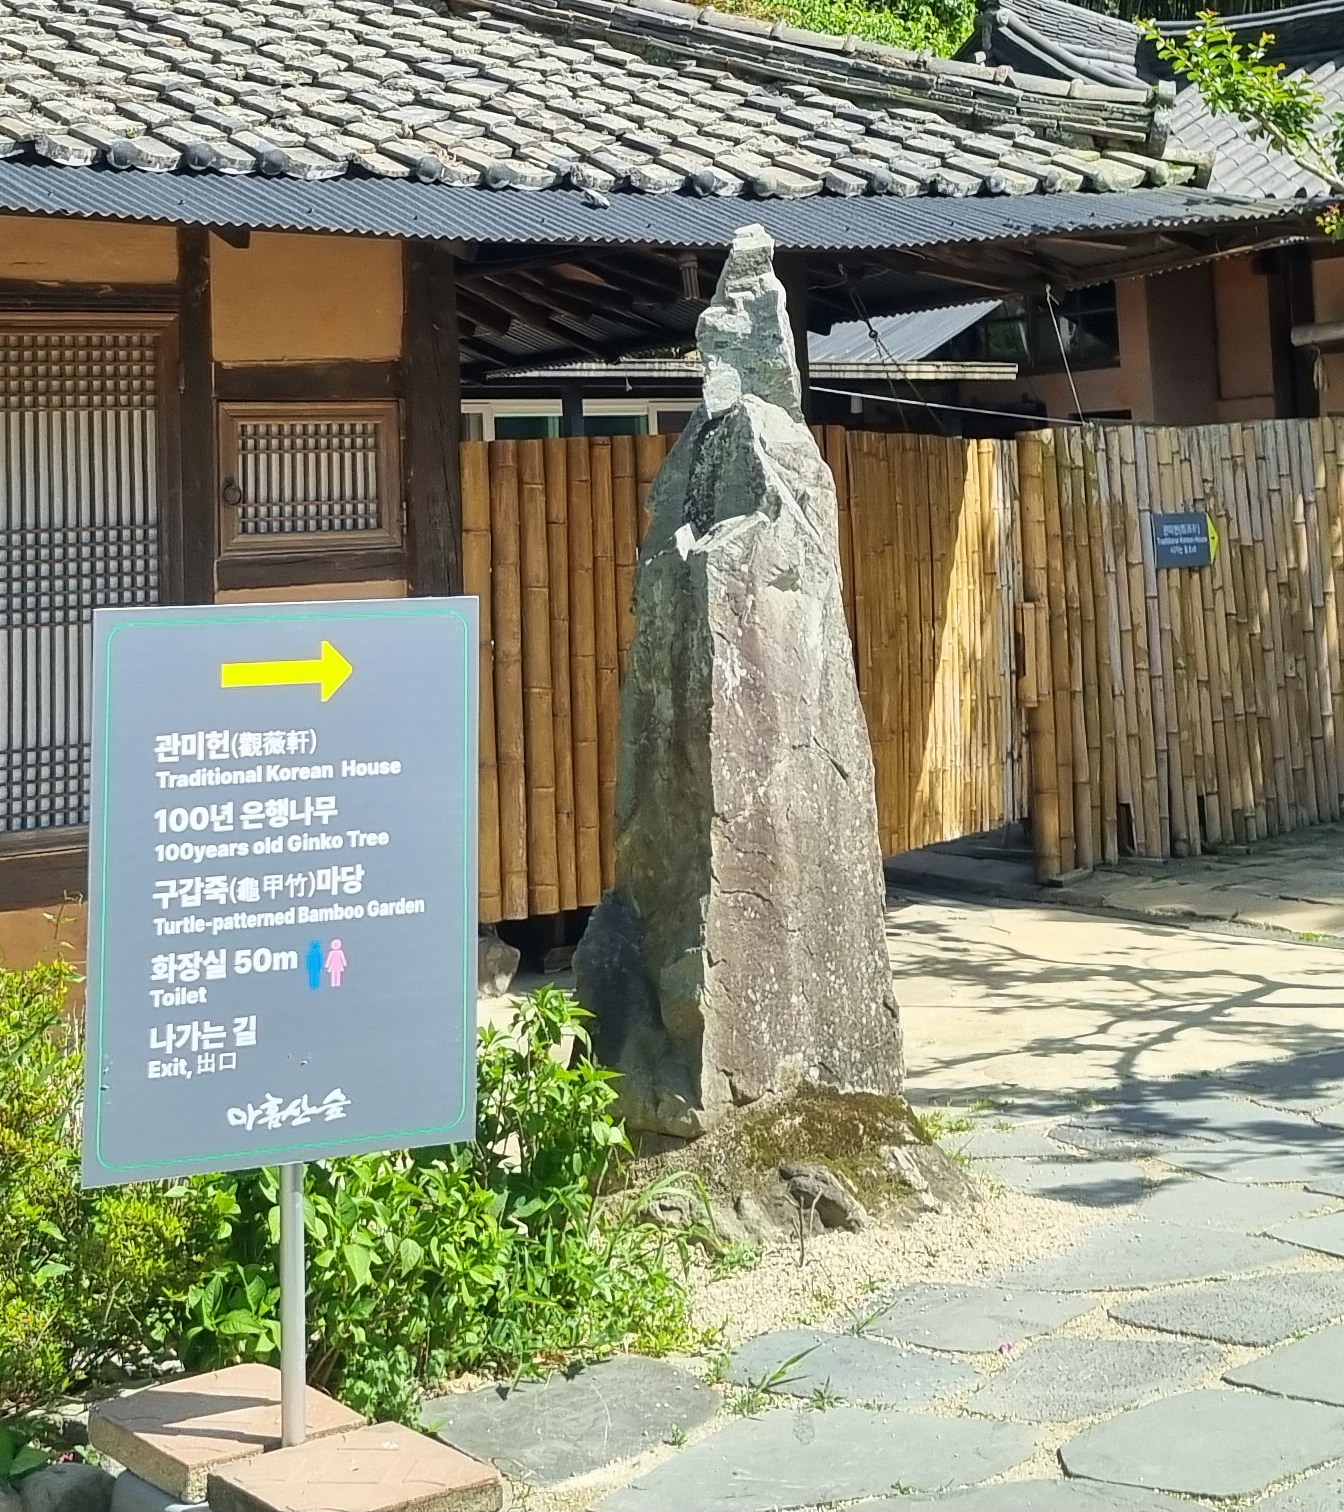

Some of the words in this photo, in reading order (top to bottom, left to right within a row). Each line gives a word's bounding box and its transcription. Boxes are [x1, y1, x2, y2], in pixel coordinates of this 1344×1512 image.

[155, 765, 263, 789] Traditional
[265, 763, 334, 783] Korean
[341, 759, 402, 778] House
[154, 801, 234, 834] 100년
[239, 795, 339, 830] 은행나무
[154, 842, 250, 864] 100years
[252, 835, 284, 855] old
[286, 832, 344, 853] Ginko
[346, 829, 390, 848] Tree
[152, 906, 296, 936] Turtle-patterned
[297, 904, 365, 924] Bamboo
[366, 897, 425, 918] Garden
[150, 948, 227, 984] 화장실
[233, 947, 298, 975] 50m
[149, 986, 208, 1008] Toilet
[149, 1020, 227, 1055] 나가는
[232, 1014, 257, 1047] 길
[147, 1057, 193, 1080] Exit,
[196, 1051, 238, 1075] 出口
